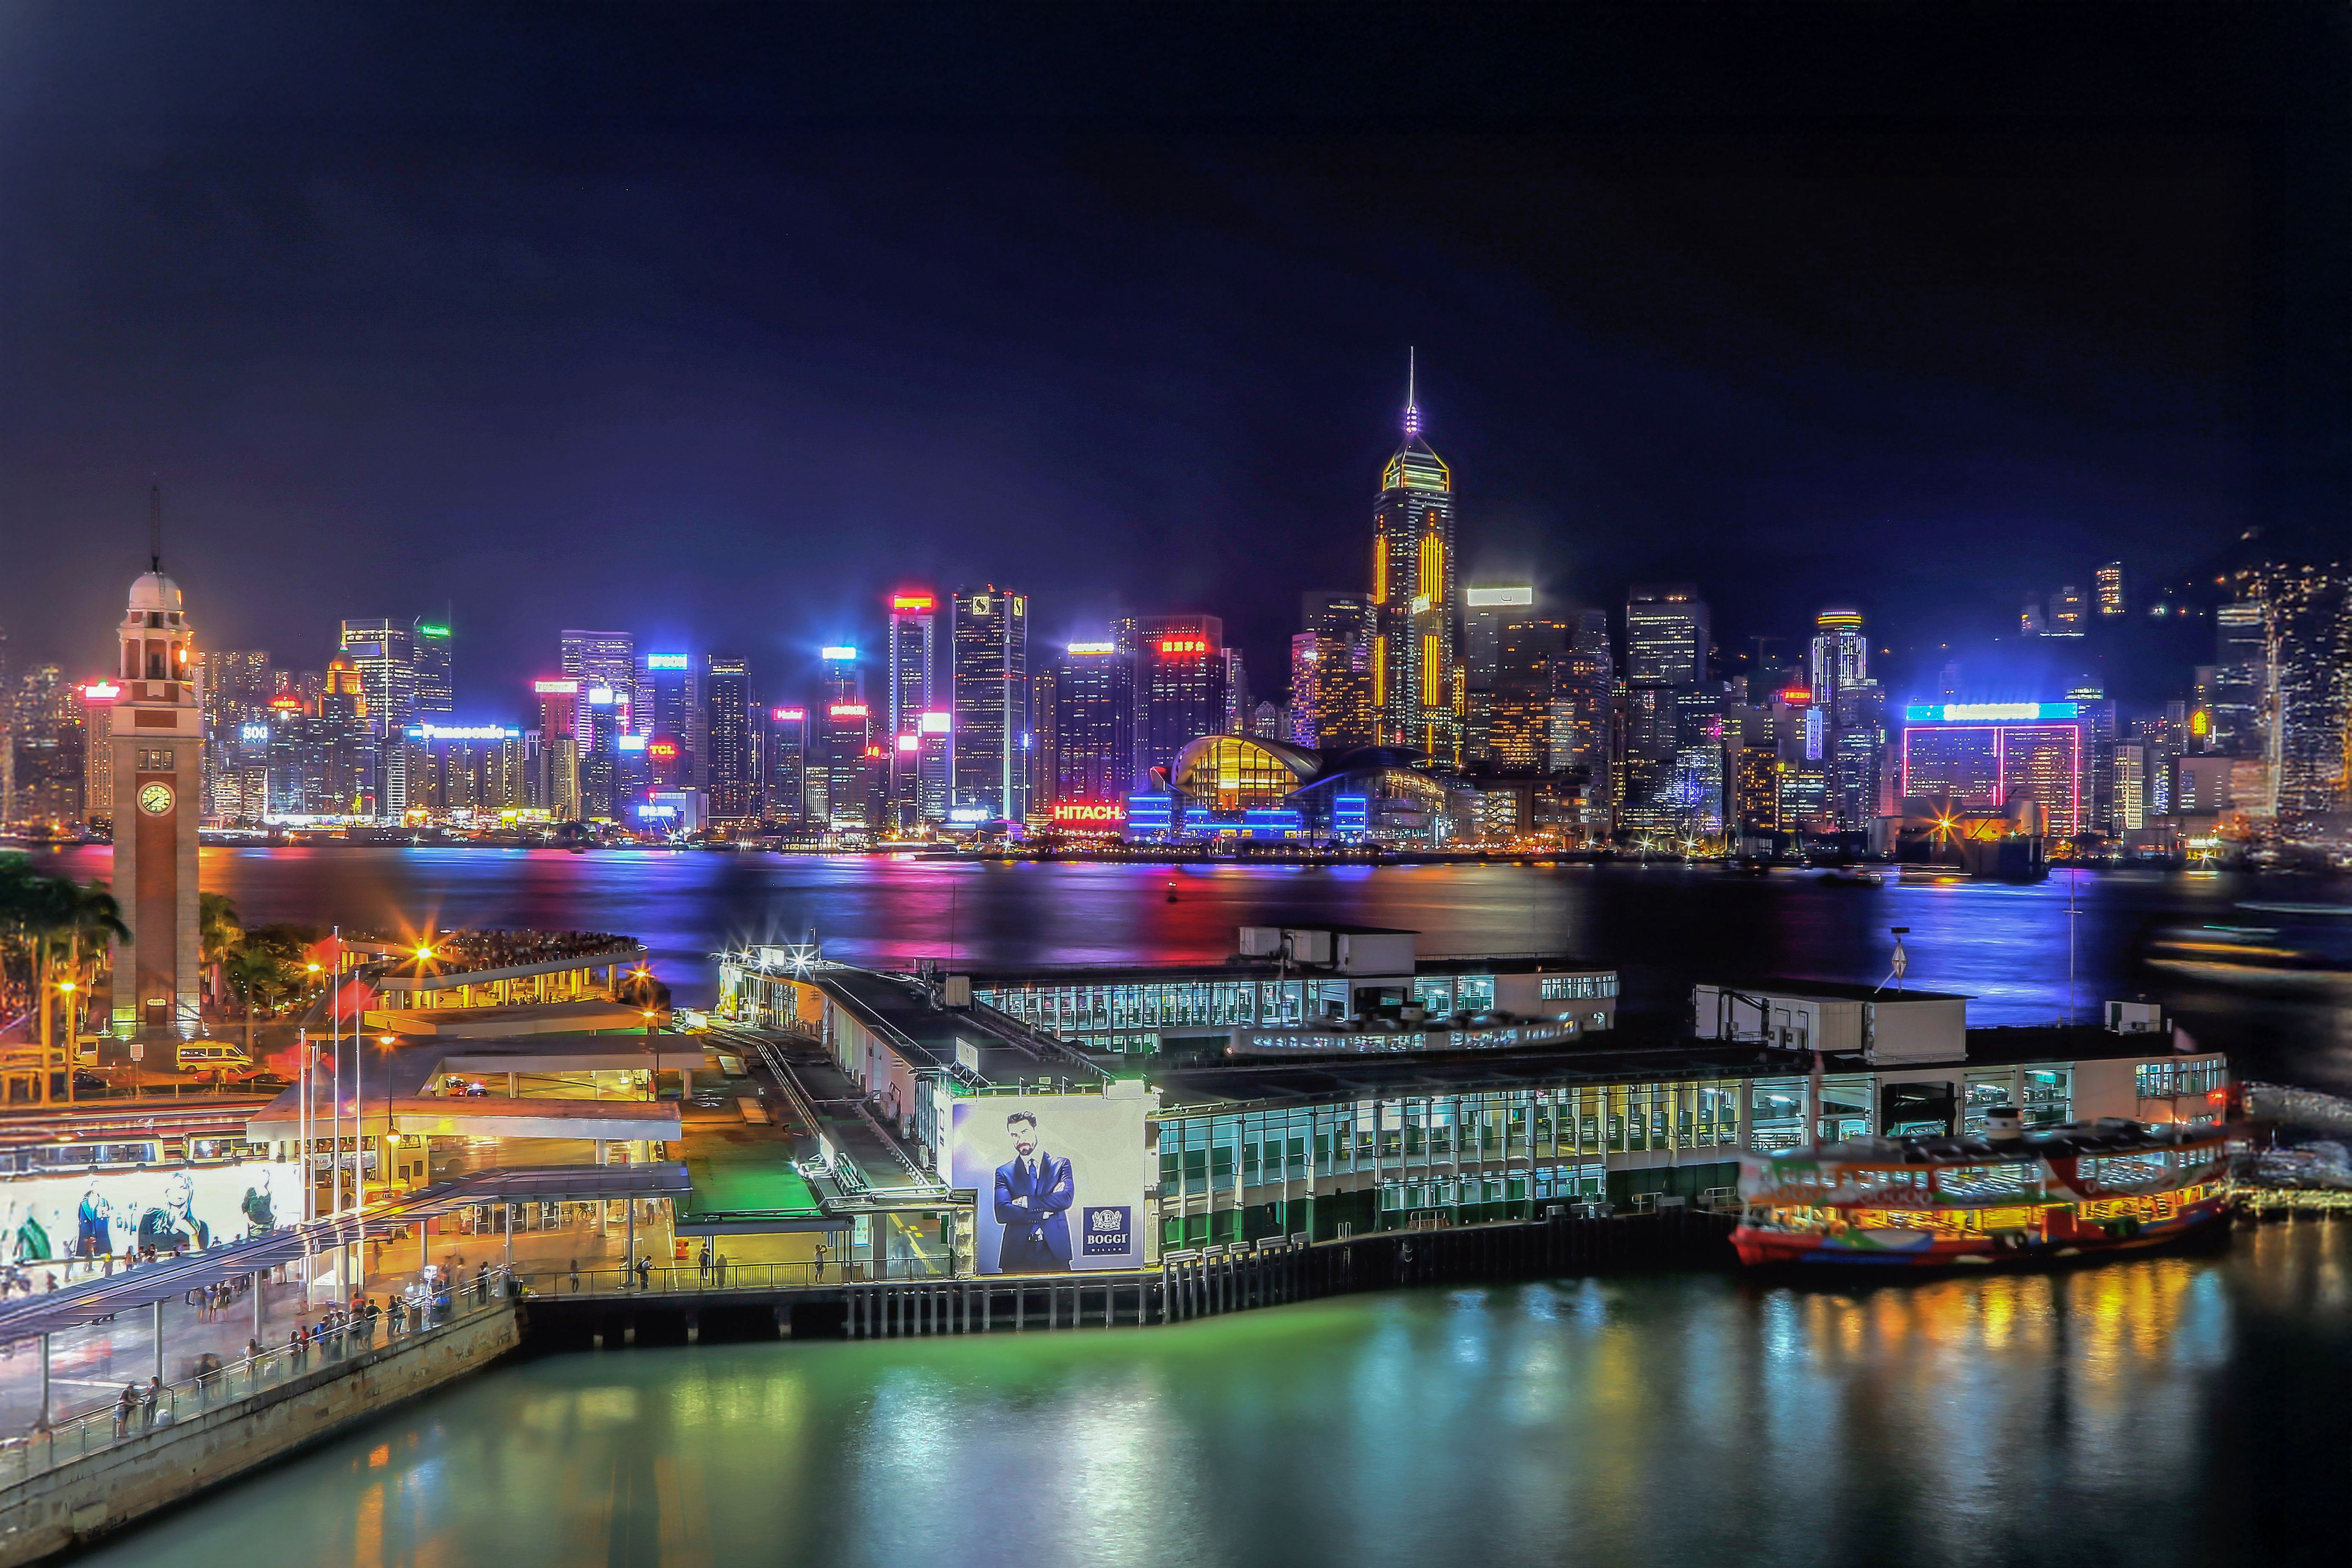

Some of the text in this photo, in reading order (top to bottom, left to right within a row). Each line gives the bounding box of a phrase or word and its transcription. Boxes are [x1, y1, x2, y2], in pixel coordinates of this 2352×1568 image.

[649, 745, 675, 755] TCL
[1055, 805, 1120, 820] HITACH
[1087, 1233, 1127, 1244] BOGGI
